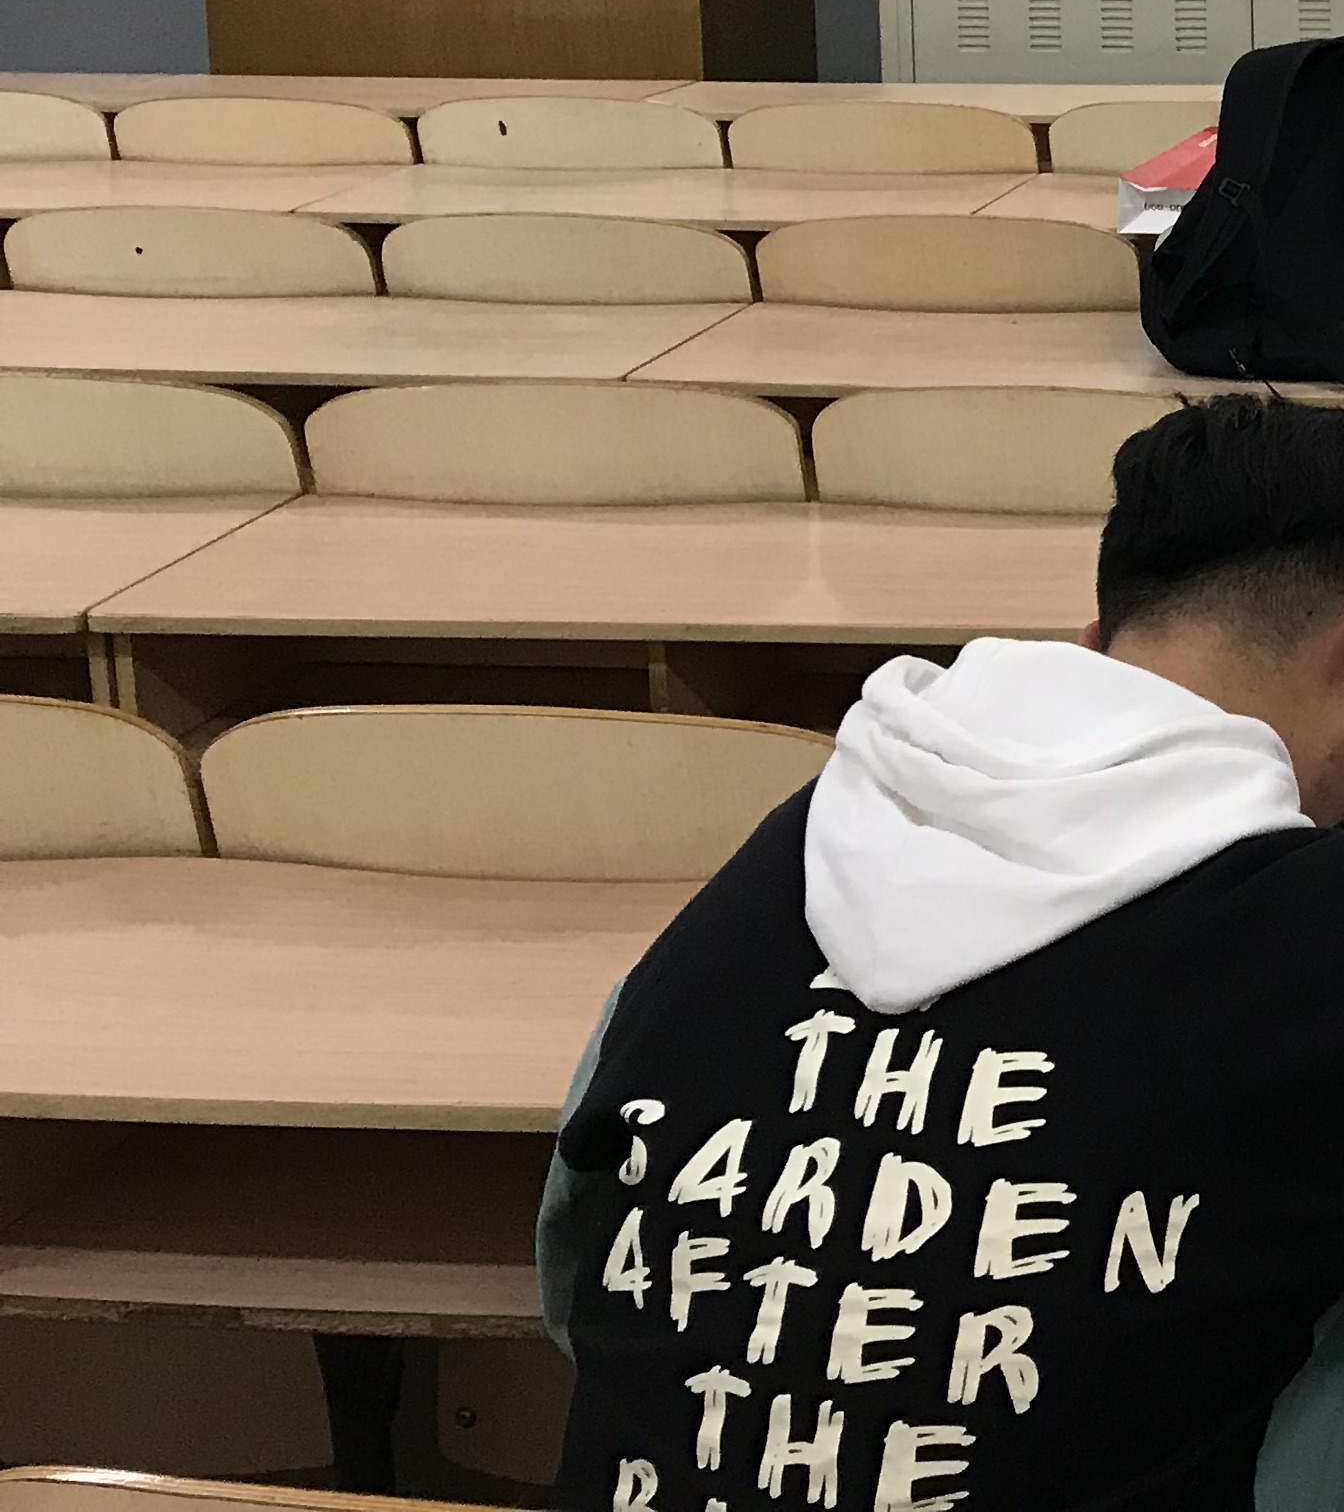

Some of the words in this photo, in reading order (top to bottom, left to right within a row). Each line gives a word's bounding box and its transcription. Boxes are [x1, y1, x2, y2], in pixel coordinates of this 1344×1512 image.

[785, 1008, 1055, 1148] THE
[602, 1207, 1041, 1415] AFTER
[684, 1364, 977, 1512] THE
